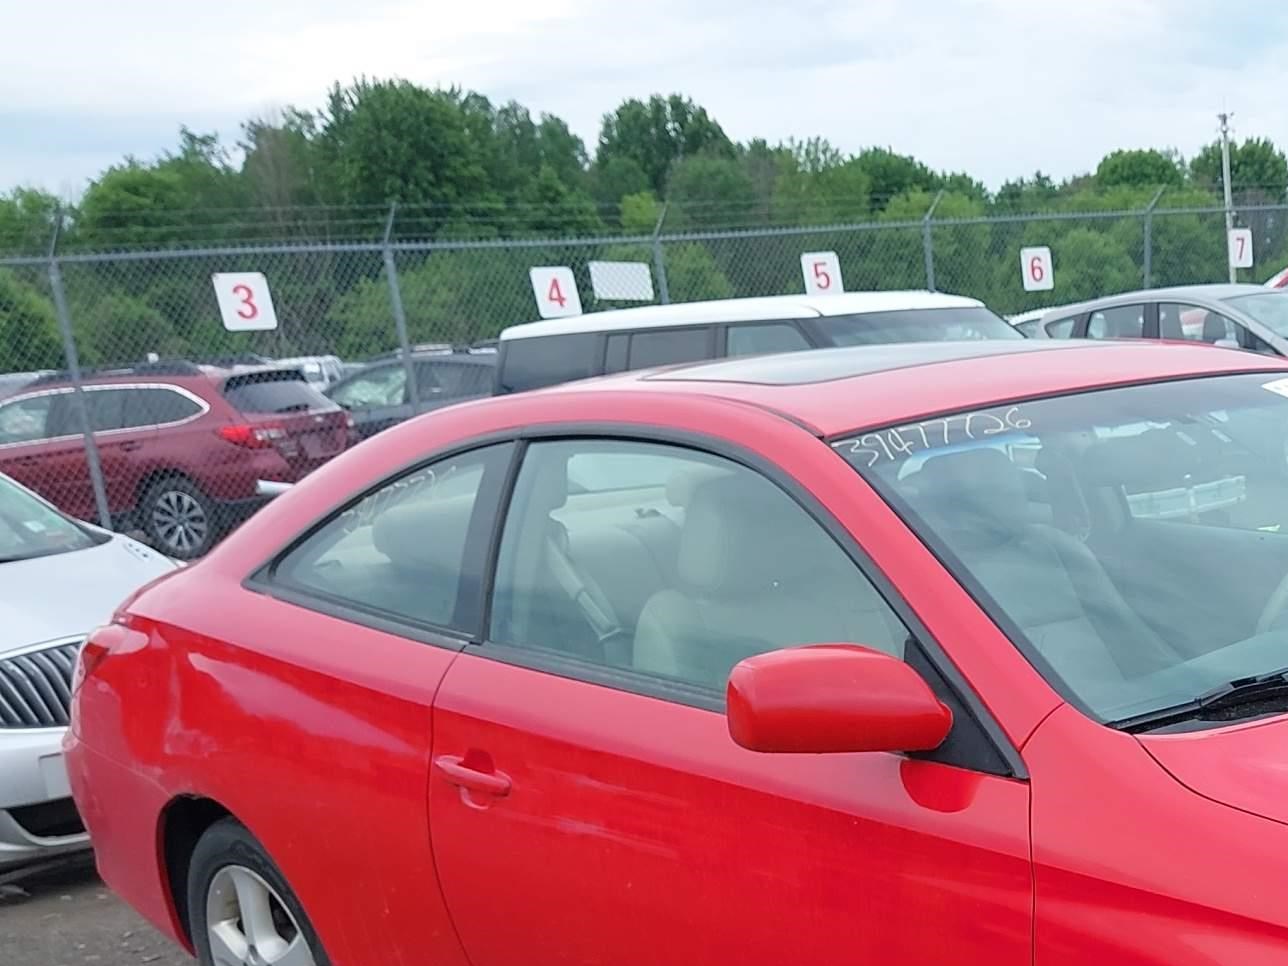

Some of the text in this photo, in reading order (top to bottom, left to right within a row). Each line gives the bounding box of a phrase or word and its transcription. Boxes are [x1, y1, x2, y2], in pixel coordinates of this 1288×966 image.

[1236, 237, 1245, 260] 7
[813, 262, 830, 290] 5
[1031, 256, 1044, 282] 6
[232, 284, 258, 319] 3
[549, 277, 566, 307] 4
